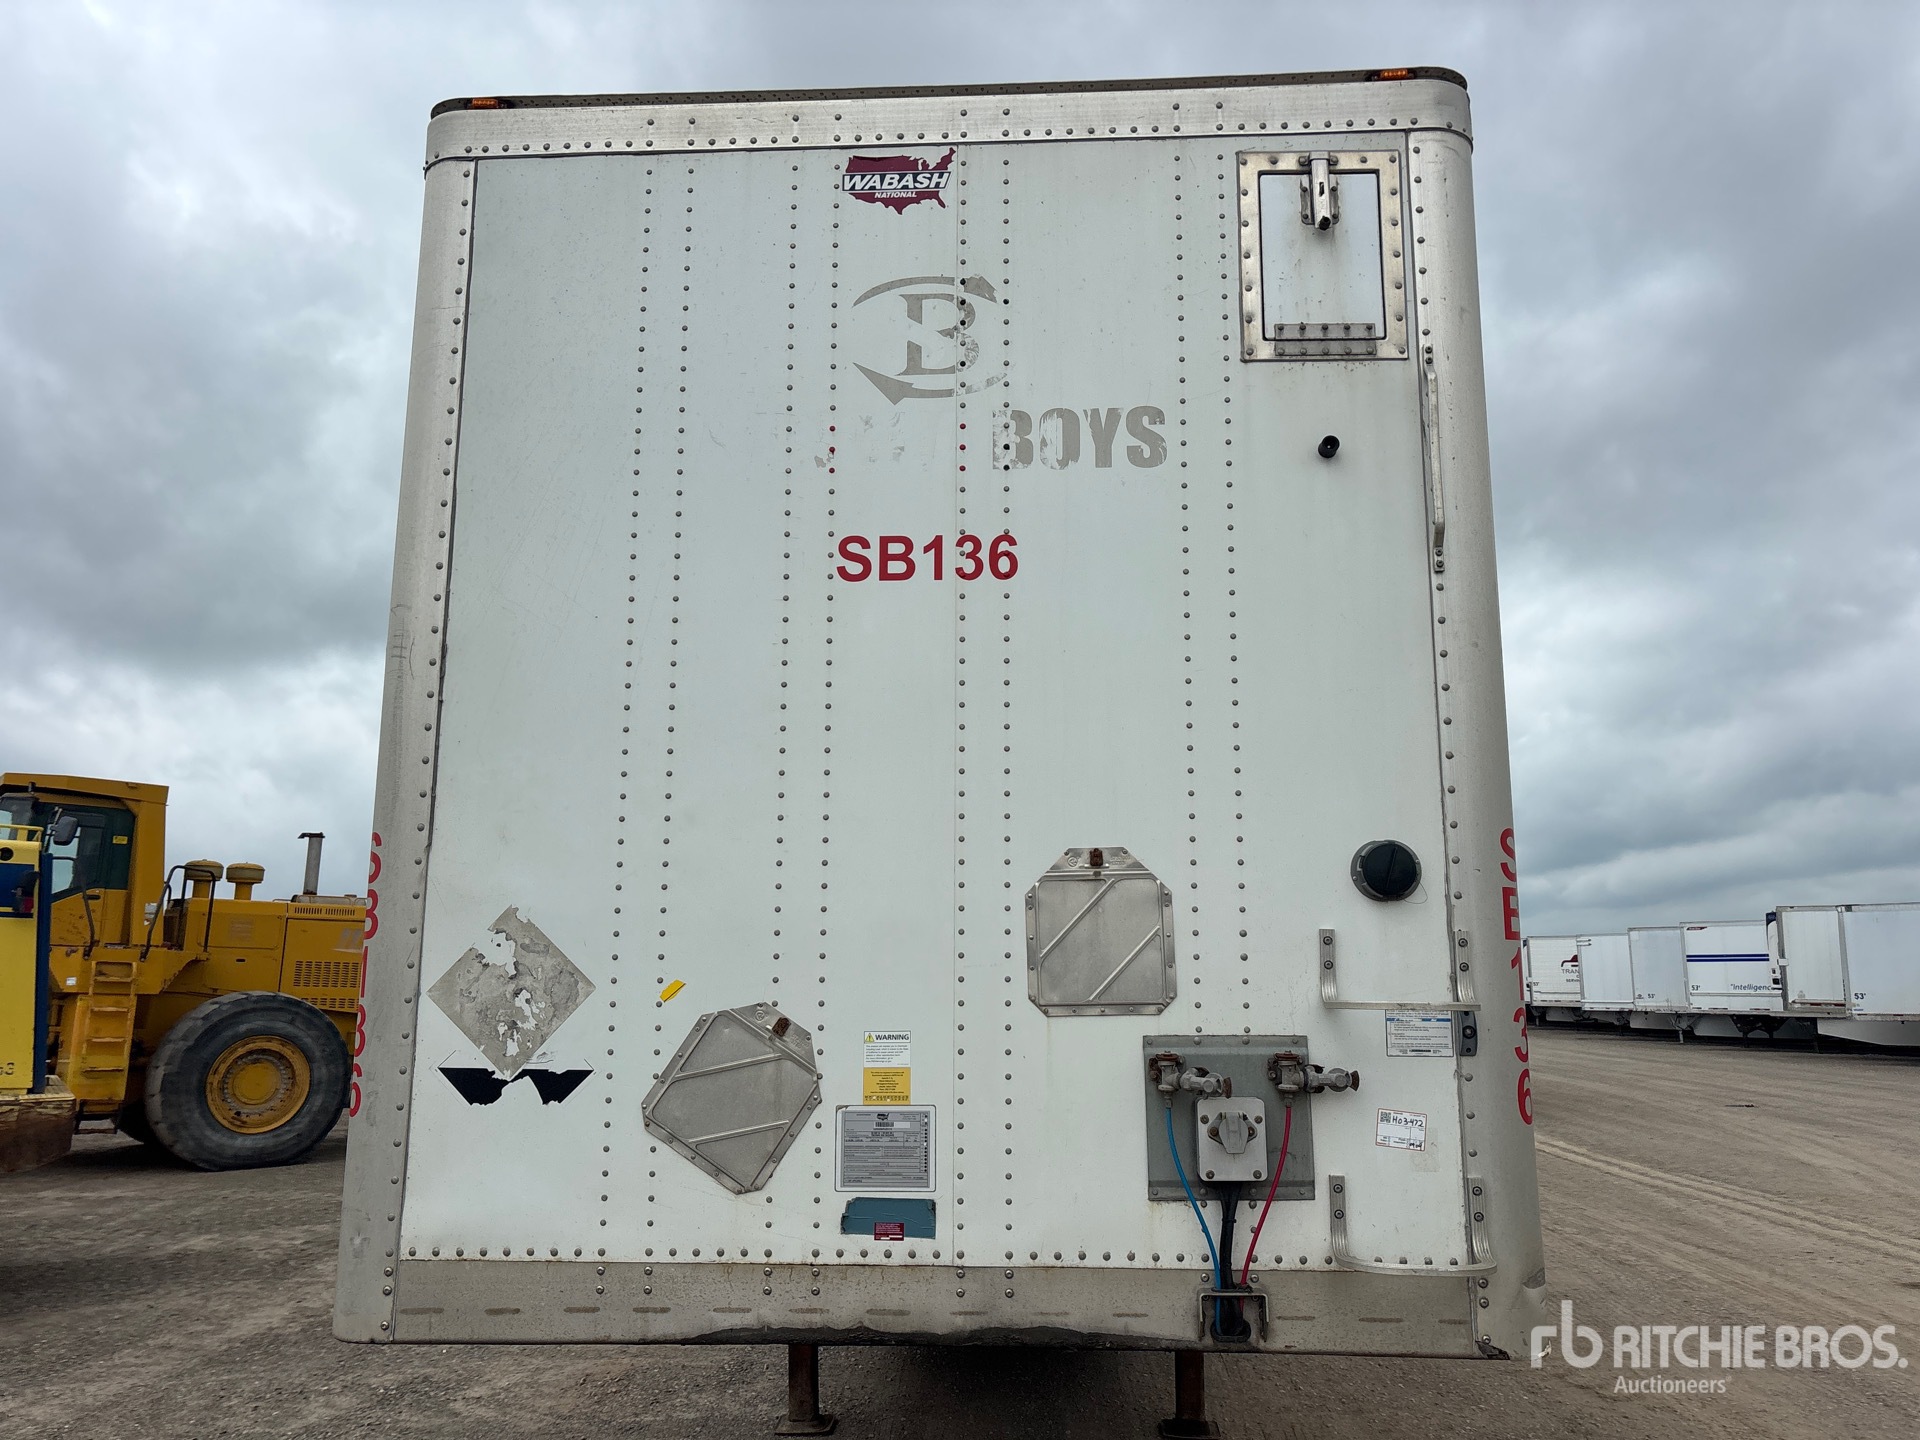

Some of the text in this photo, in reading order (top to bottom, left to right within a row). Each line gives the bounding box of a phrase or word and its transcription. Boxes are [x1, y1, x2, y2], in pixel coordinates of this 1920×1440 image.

[843, 172, 950, 190] WABASH
[874, 191, 918, 199] NATIONAL
[992, 405, 1168, 470] BOYS
[836, 534, 1019, 582] SB136
[1854, 992, 1867, 1000] 53'
[875, 1033, 910, 1041] WARNING
